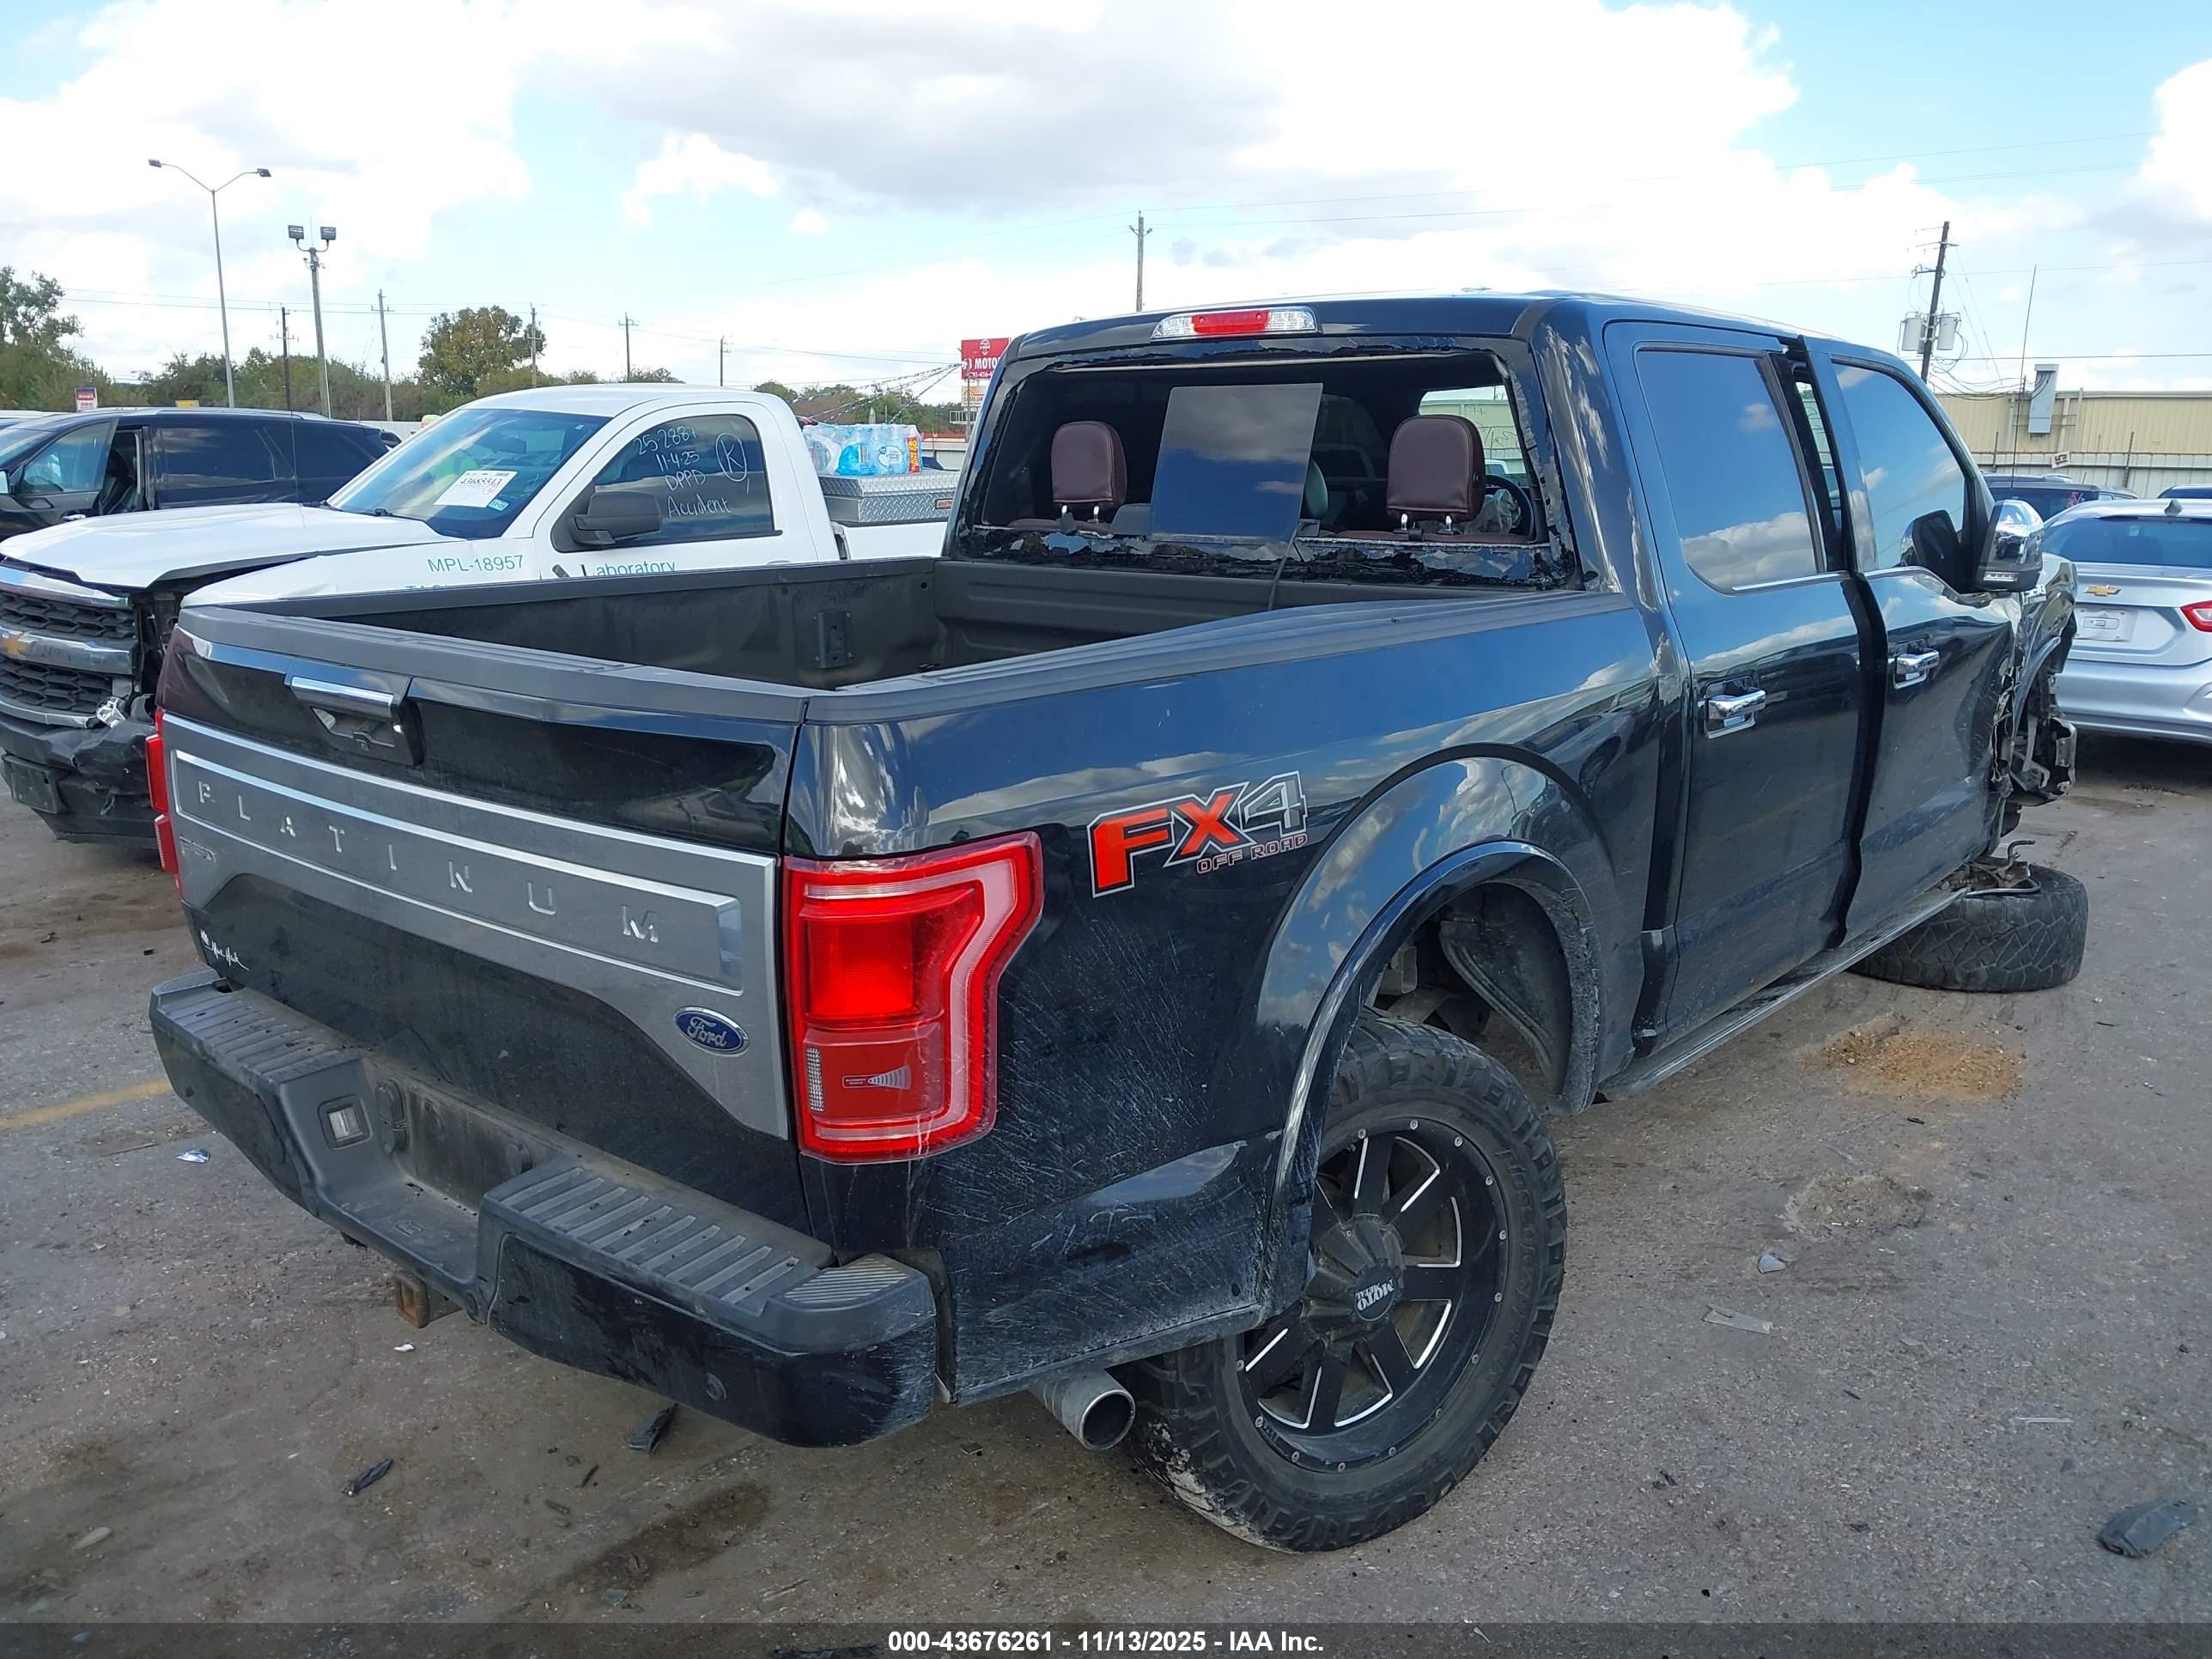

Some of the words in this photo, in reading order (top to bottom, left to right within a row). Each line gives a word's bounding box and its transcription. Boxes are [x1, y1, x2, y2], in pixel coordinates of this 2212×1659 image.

[975, 356, 1001, 370] MOTO
[665, 469, 706, 491] DPPD
[666, 493, 733, 520] Accident
[428, 554, 523, 573] MPL-18957
[1086, 770, 1308, 898] FX4
[198, 780, 659, 943] PLATINUM
[1197, 849, 1243, 874] OFF
[1250, 833, 1309, 860] ROAD
[687, 1016, 727, 1046] Ford
